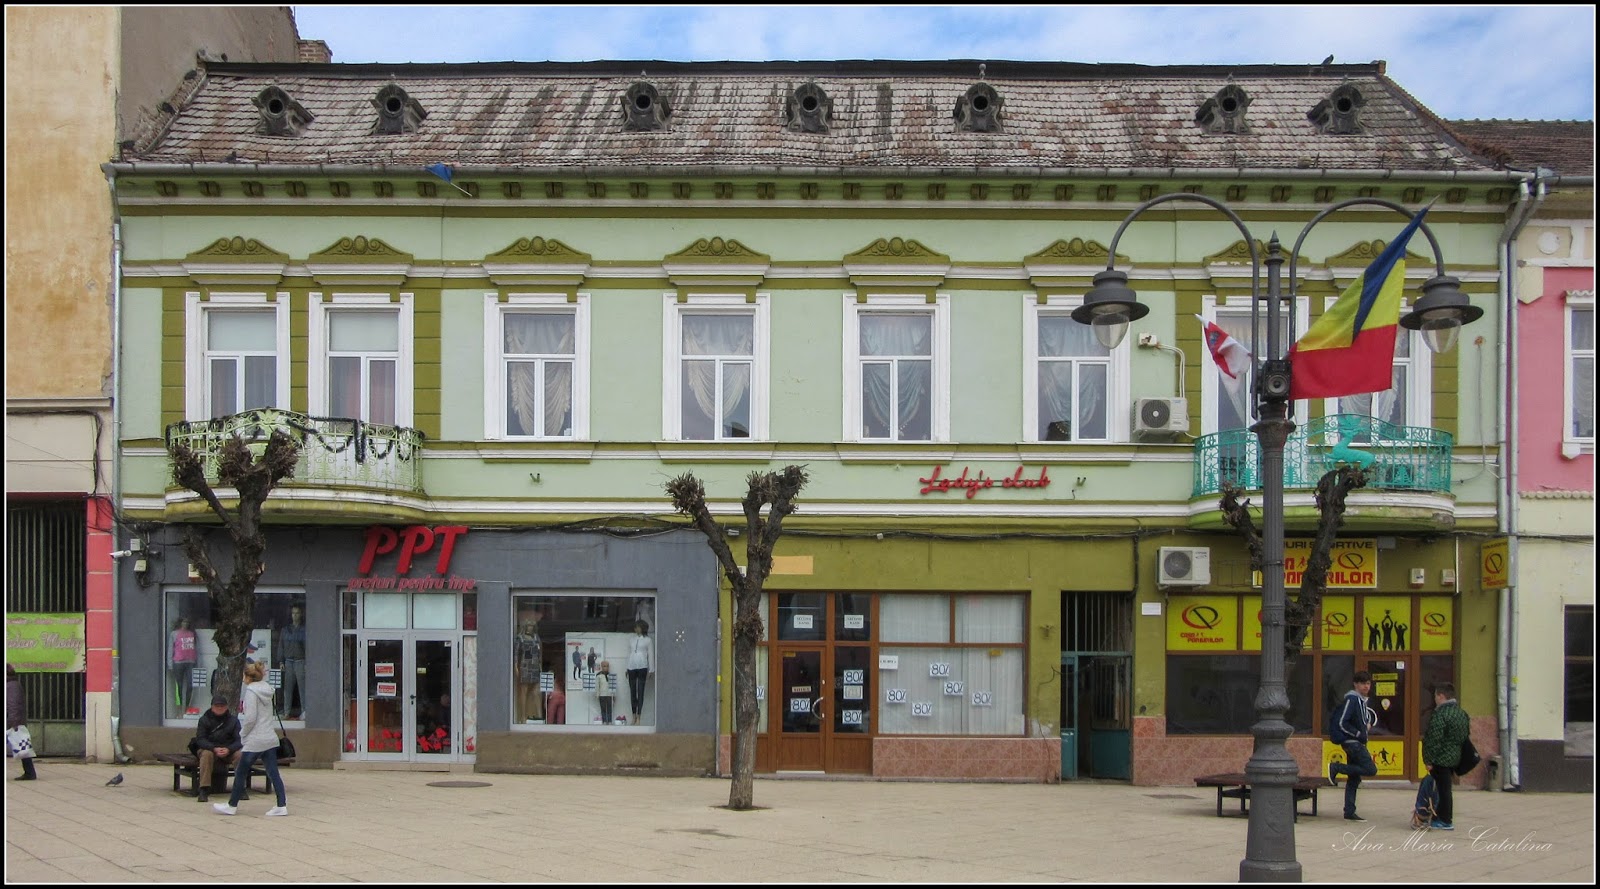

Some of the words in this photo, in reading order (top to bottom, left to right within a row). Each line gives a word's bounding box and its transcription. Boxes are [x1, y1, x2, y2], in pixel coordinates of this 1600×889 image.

[919, 465, 993, 499] Lady's
[1002, 465, 1051, 488] club
[358, 523, 469, 574] PPT
